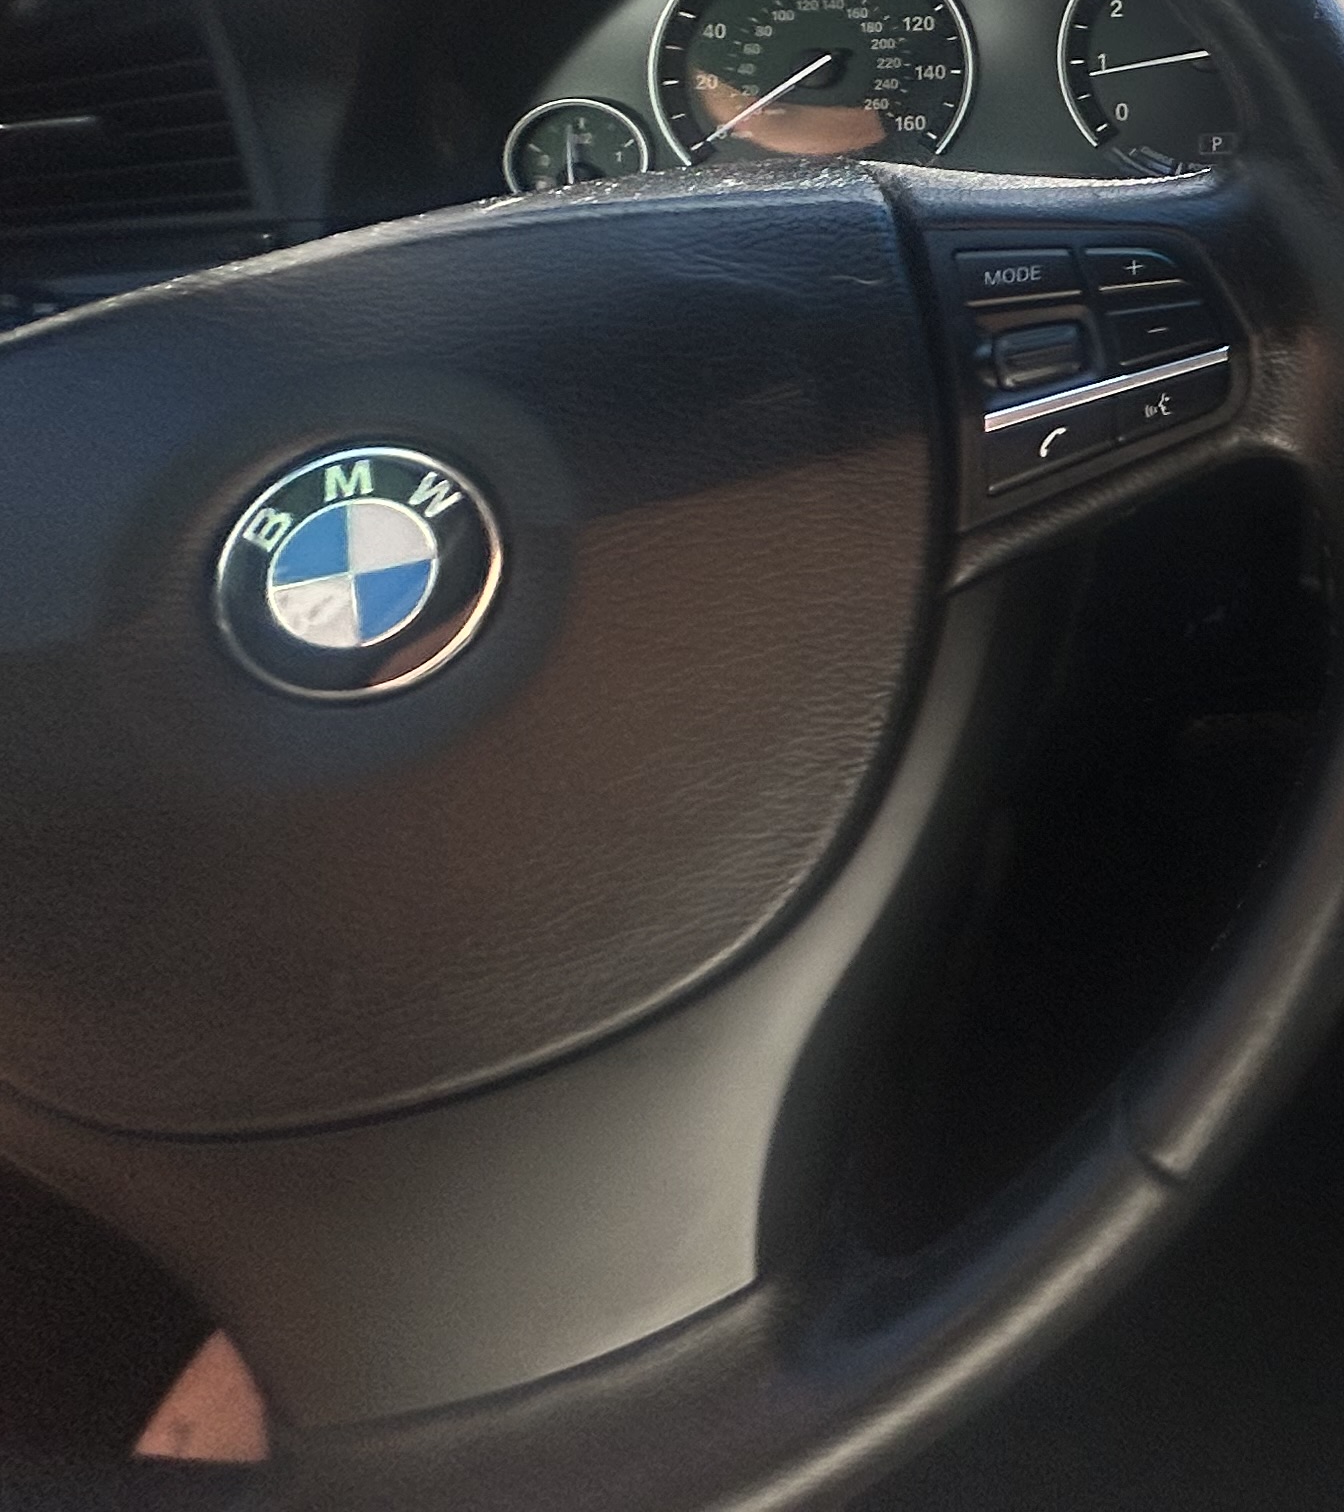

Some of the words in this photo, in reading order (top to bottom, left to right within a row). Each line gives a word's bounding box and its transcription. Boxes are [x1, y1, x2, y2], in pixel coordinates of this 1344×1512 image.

[797, 0, 819, 11] 120
[1110, 0, 1125, 18] 2
[771, 9, 796, 22] 100
[902, 15, 935, 32] 120
[702, 22, 727, 39] 40
[870, 37, 896, 50] 200
[876, 57, 902, 70] 220
[1097, 52, 1107, 71] 1
[914, 64, 947, 80] 140
[695, 72, 719, 90] 20
[874, 77, 899, 90] 240
[864, 98, 890, 111] 260
[1114, 102, 1130, 122] 0
[894, 114, 927, 132] 160
[1211, 136, 1223, 152] P
[984, 265, 1042, 286] MODE
[242, 458, 463, 553] BMW
